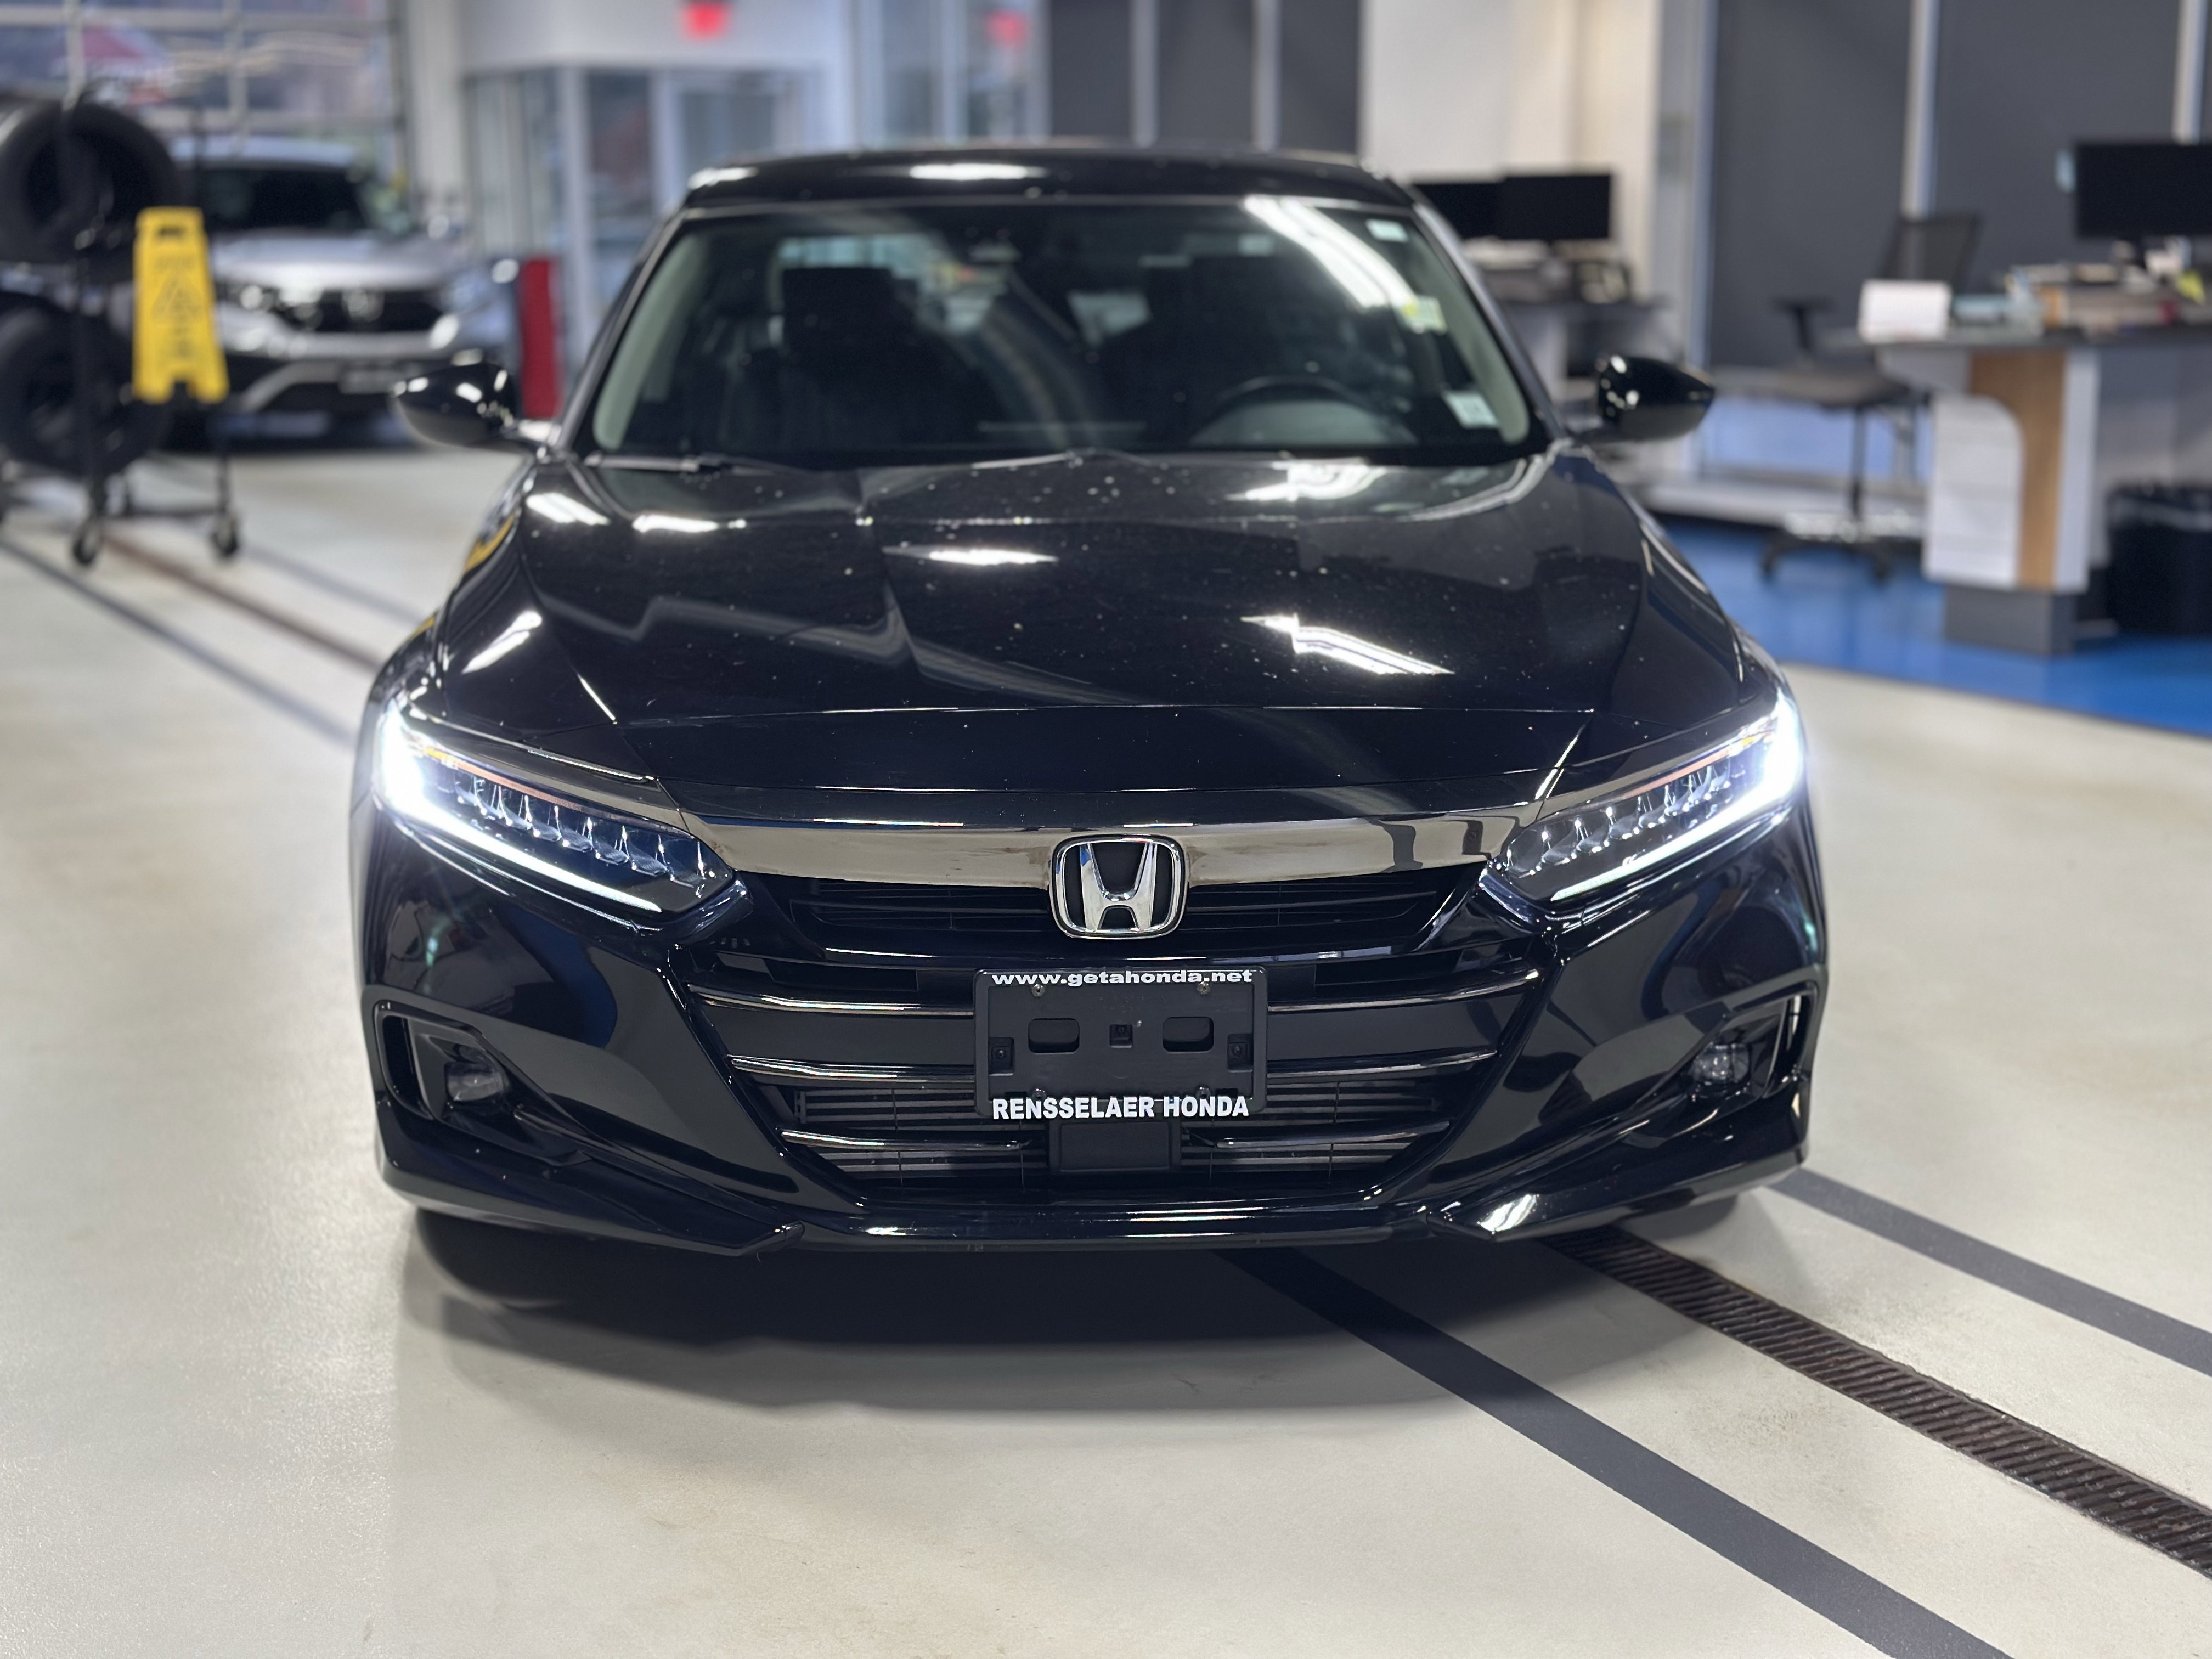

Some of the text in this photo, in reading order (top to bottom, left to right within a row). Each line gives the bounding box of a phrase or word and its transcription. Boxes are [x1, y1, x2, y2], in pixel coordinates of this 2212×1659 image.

[992, 970, 1252, 986] www.getahonda.net
[992, 1096, 1249, 1119] RENSSELAER HONDA
